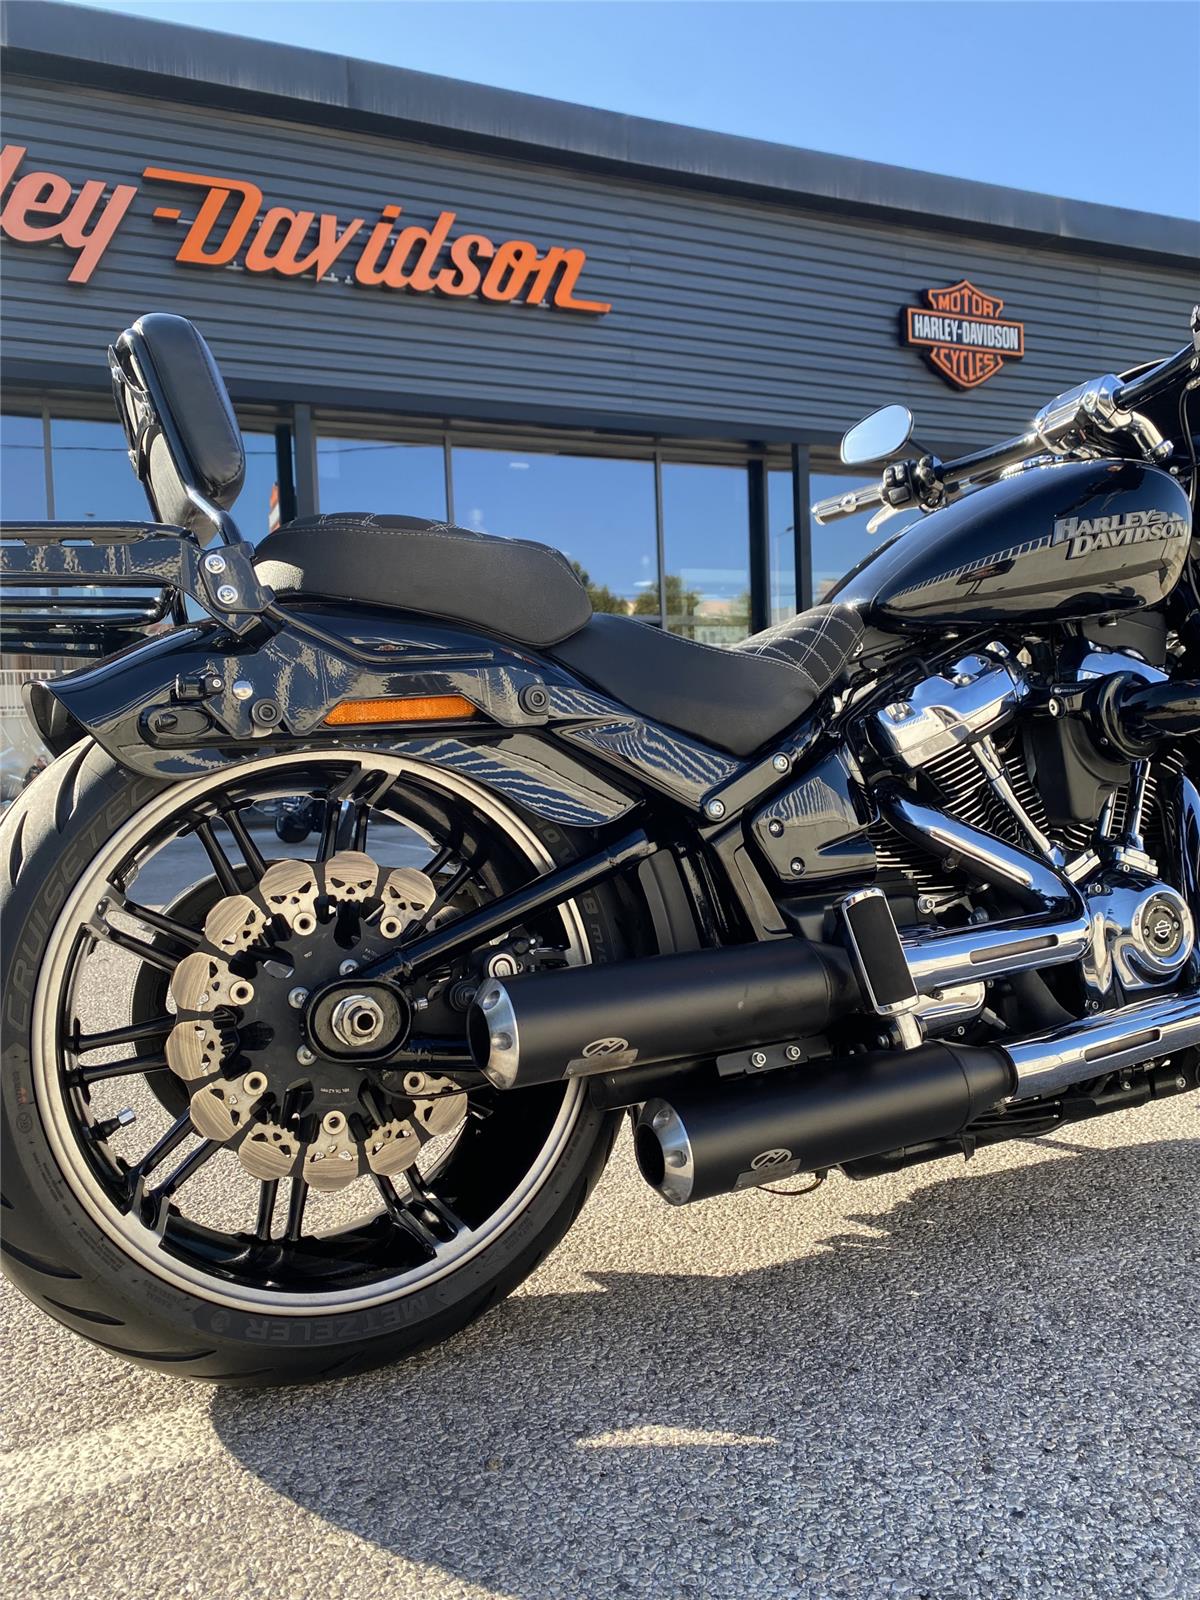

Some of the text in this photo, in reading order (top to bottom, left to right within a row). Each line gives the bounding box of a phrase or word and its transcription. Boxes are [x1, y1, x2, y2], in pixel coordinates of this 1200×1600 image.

[938, 288, 994, 317] MOTOR
[913, 314, 1019, 350] HARLEY-DAVIDSON
[940, 348, 995, 382] CYCLES
[1069, 521, 1186, 559] DAVIDSON
[6, 778, 155, 1033] CRUISETEC
[245, 1296, 431, 1341] METZELER
